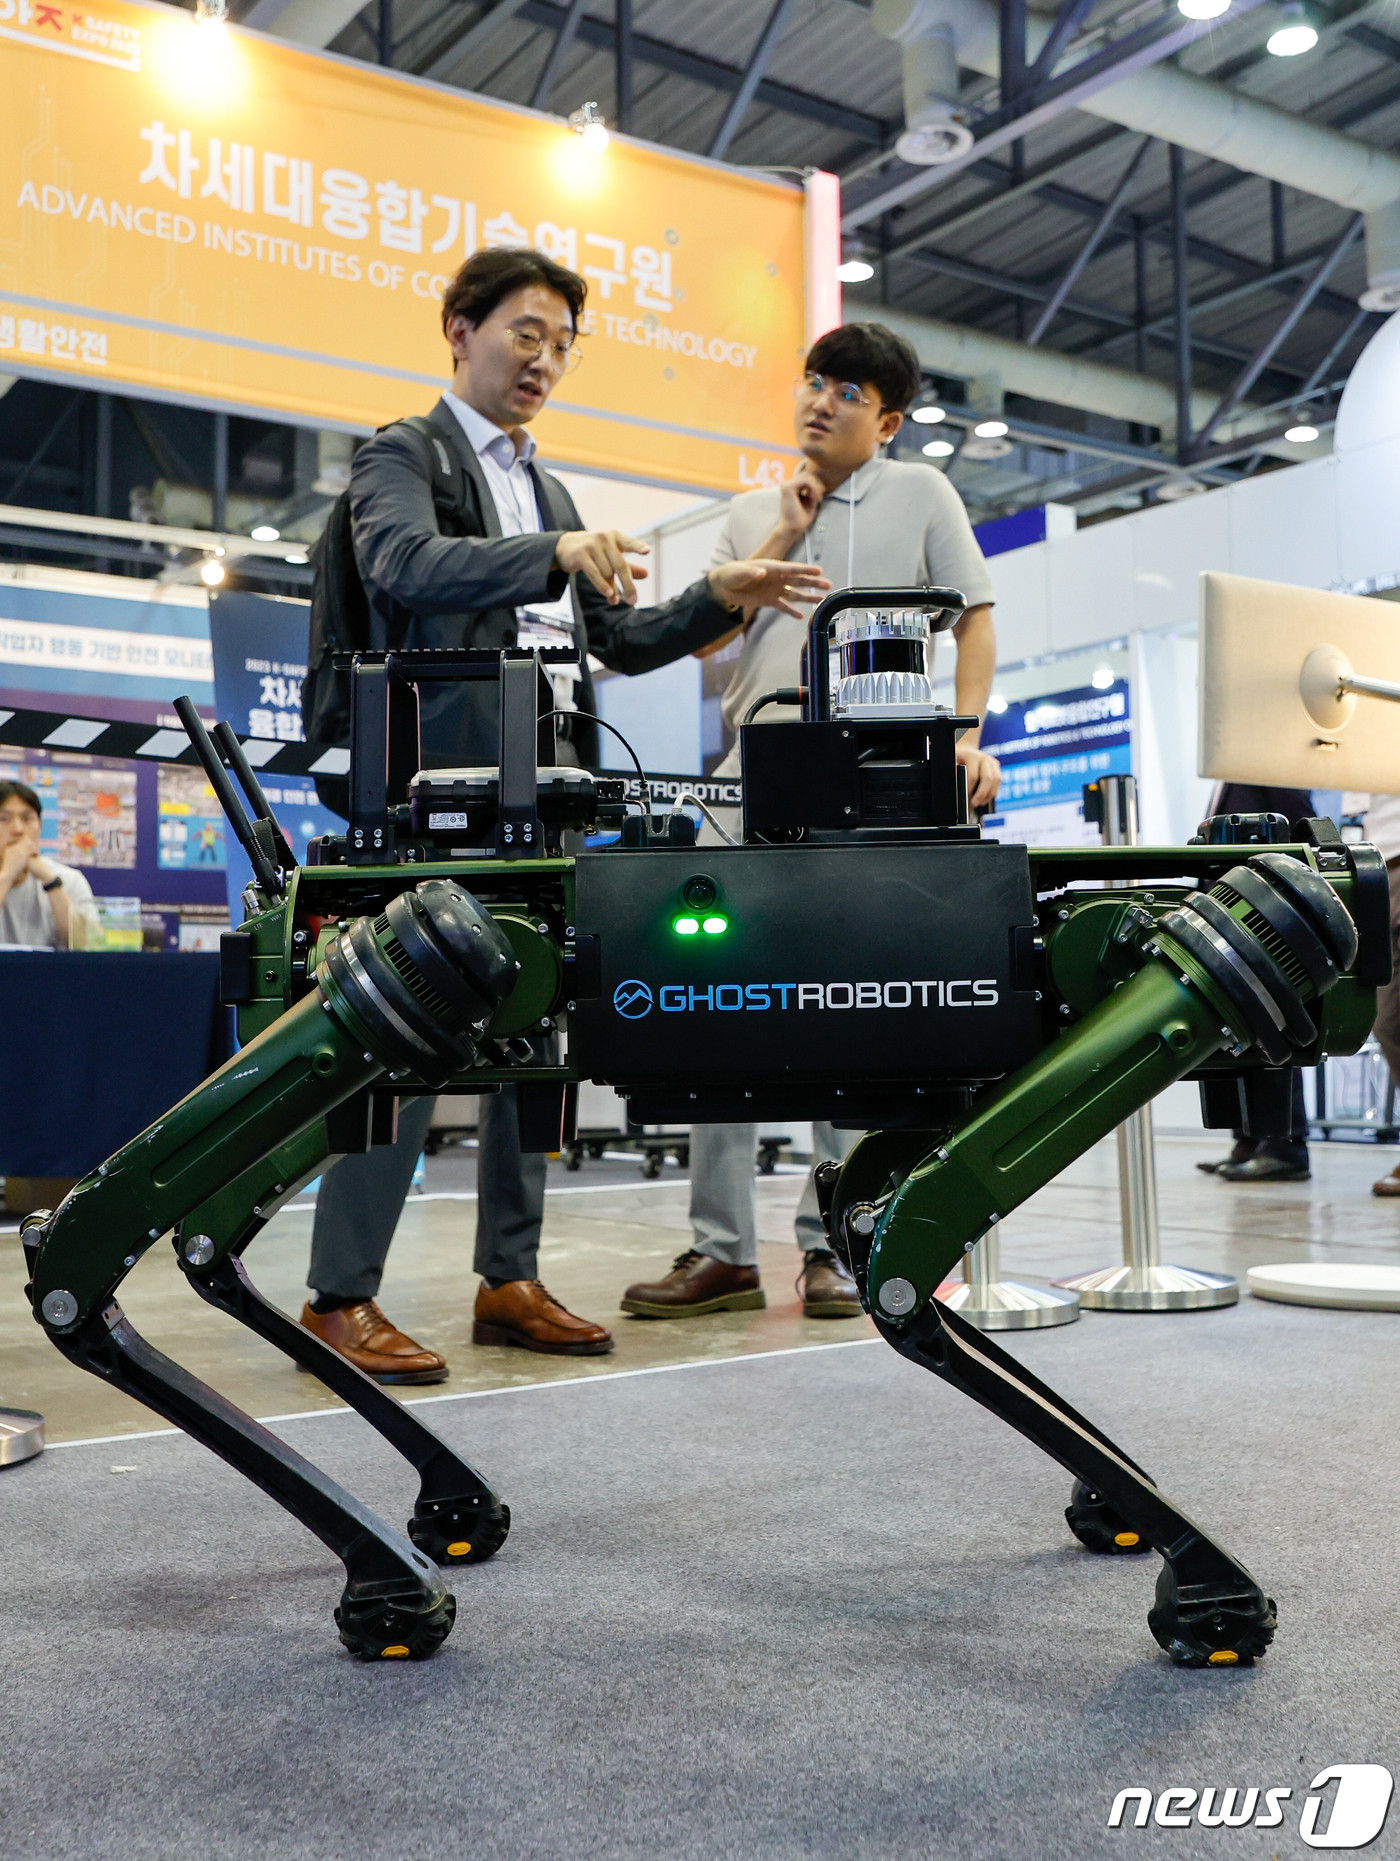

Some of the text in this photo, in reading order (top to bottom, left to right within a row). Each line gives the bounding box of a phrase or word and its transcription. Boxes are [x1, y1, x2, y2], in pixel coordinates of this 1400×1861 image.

[72, 26, 108, 47] EXPO
[85, 15, 139, 41] SAFETY
[17, 180, 196, 243] ADVANCED
[203, 221, 362, 282] INSTITUTES
[367, 260, 405, 290] OF
[602, 312, 758, 369] TECHNOLOGY
[659, 979, 999, 1012] GHOSTROBOTICS
